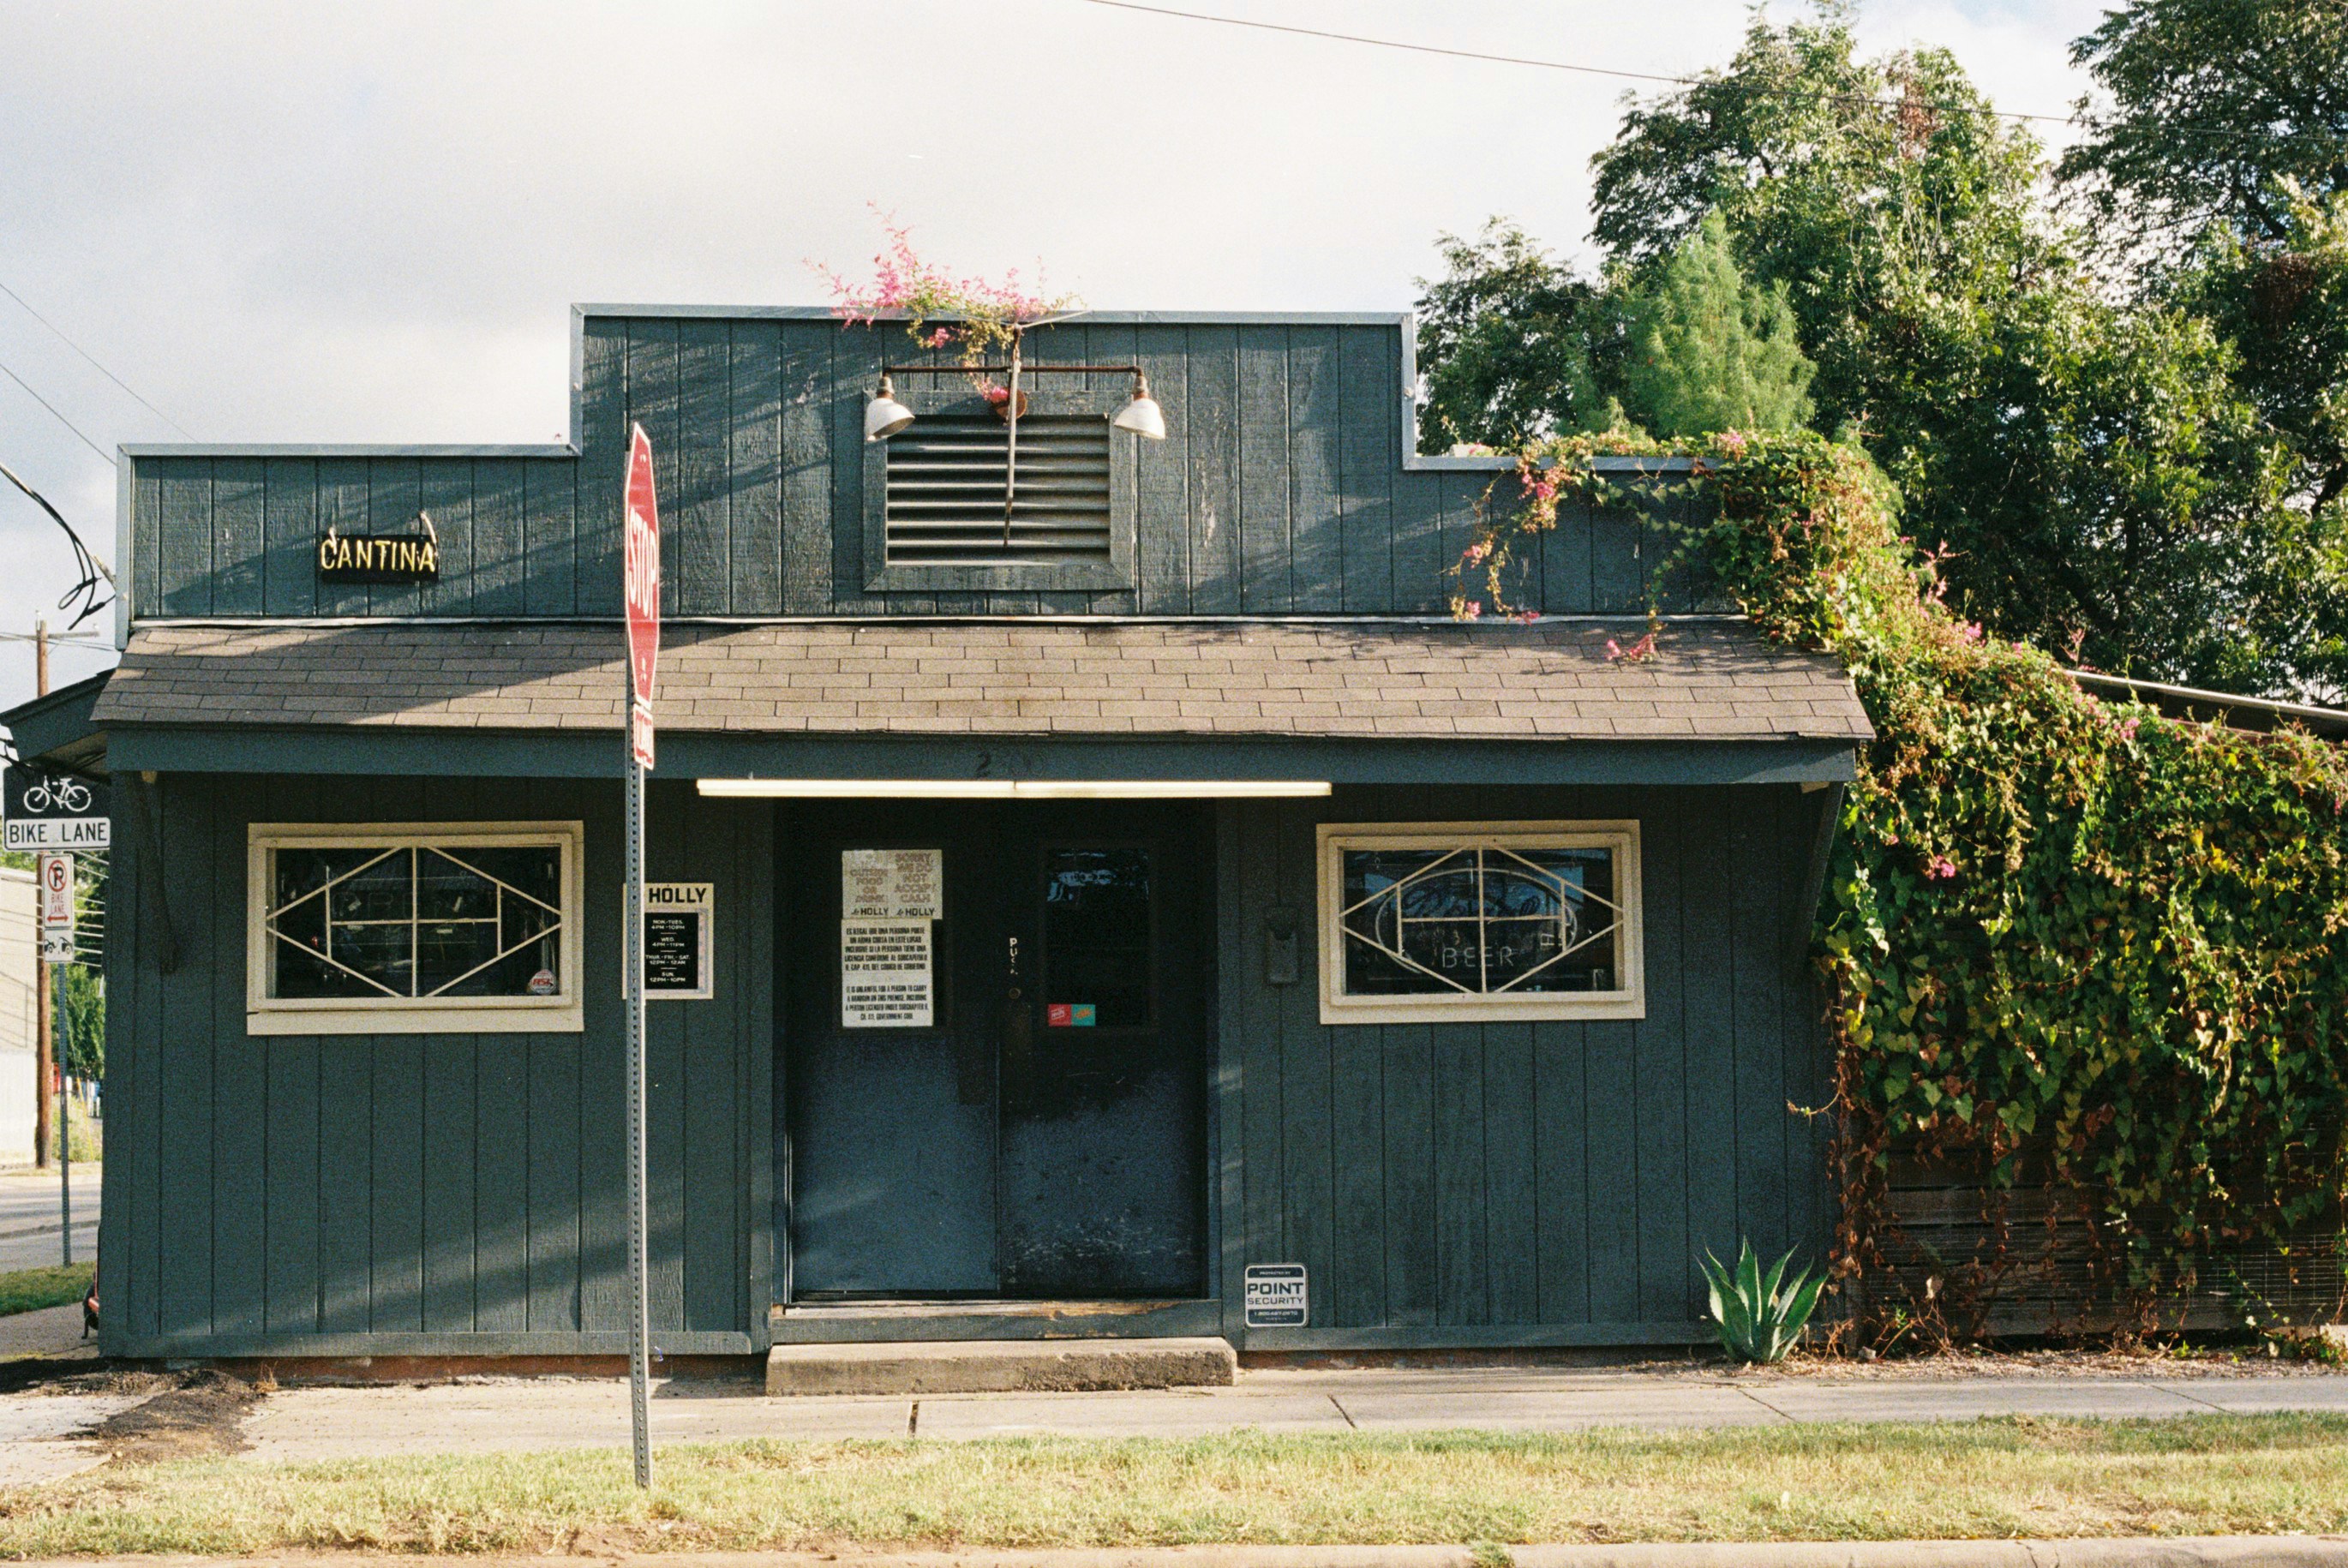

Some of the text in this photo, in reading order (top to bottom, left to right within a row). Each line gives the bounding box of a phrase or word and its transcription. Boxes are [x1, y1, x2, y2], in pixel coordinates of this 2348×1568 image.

[320, 538, 435, 572] CANTINA
[629, 507, 656, 620] STOP
[9, 823, 107, 843] BIKE LANE
[51, 894, 65, 913] BIKE LANE
[649, 888, 707, 903] HOLLY
[905, 908, 935, 917] HOLLY
[1442, 946, 1514, 968] BEER
[1247, 1283, 1304, 1295] POINT
